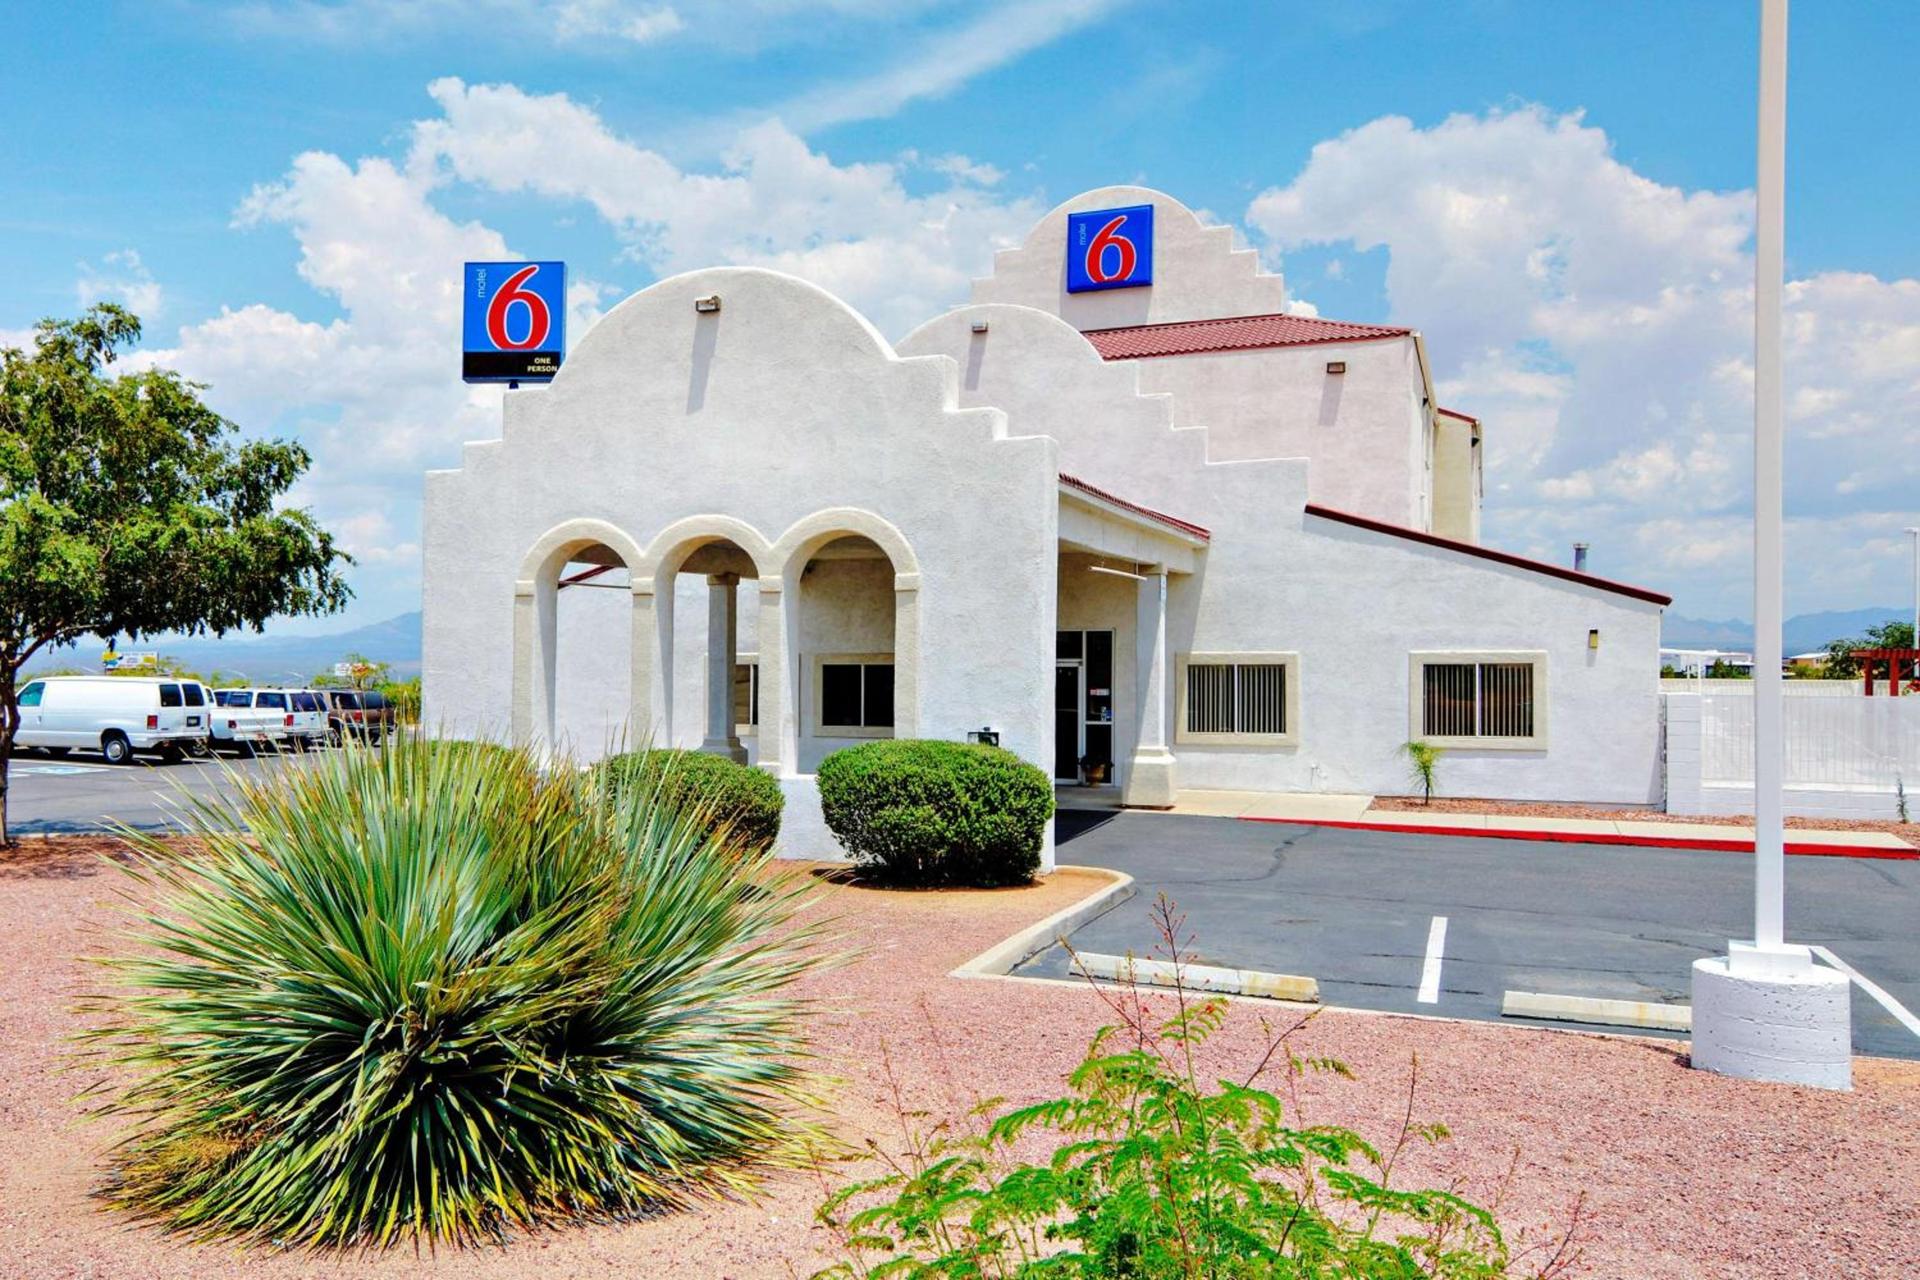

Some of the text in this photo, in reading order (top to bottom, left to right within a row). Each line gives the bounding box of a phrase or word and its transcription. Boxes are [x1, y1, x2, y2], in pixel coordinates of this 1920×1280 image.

[1085, 215, 1137, 284] 6
[476, 268, 487, 298] motel
[486, 264, 551, 351] 6
[527, 365, 558, 373] PERSON
[534, 357, 552, 365] ONE
